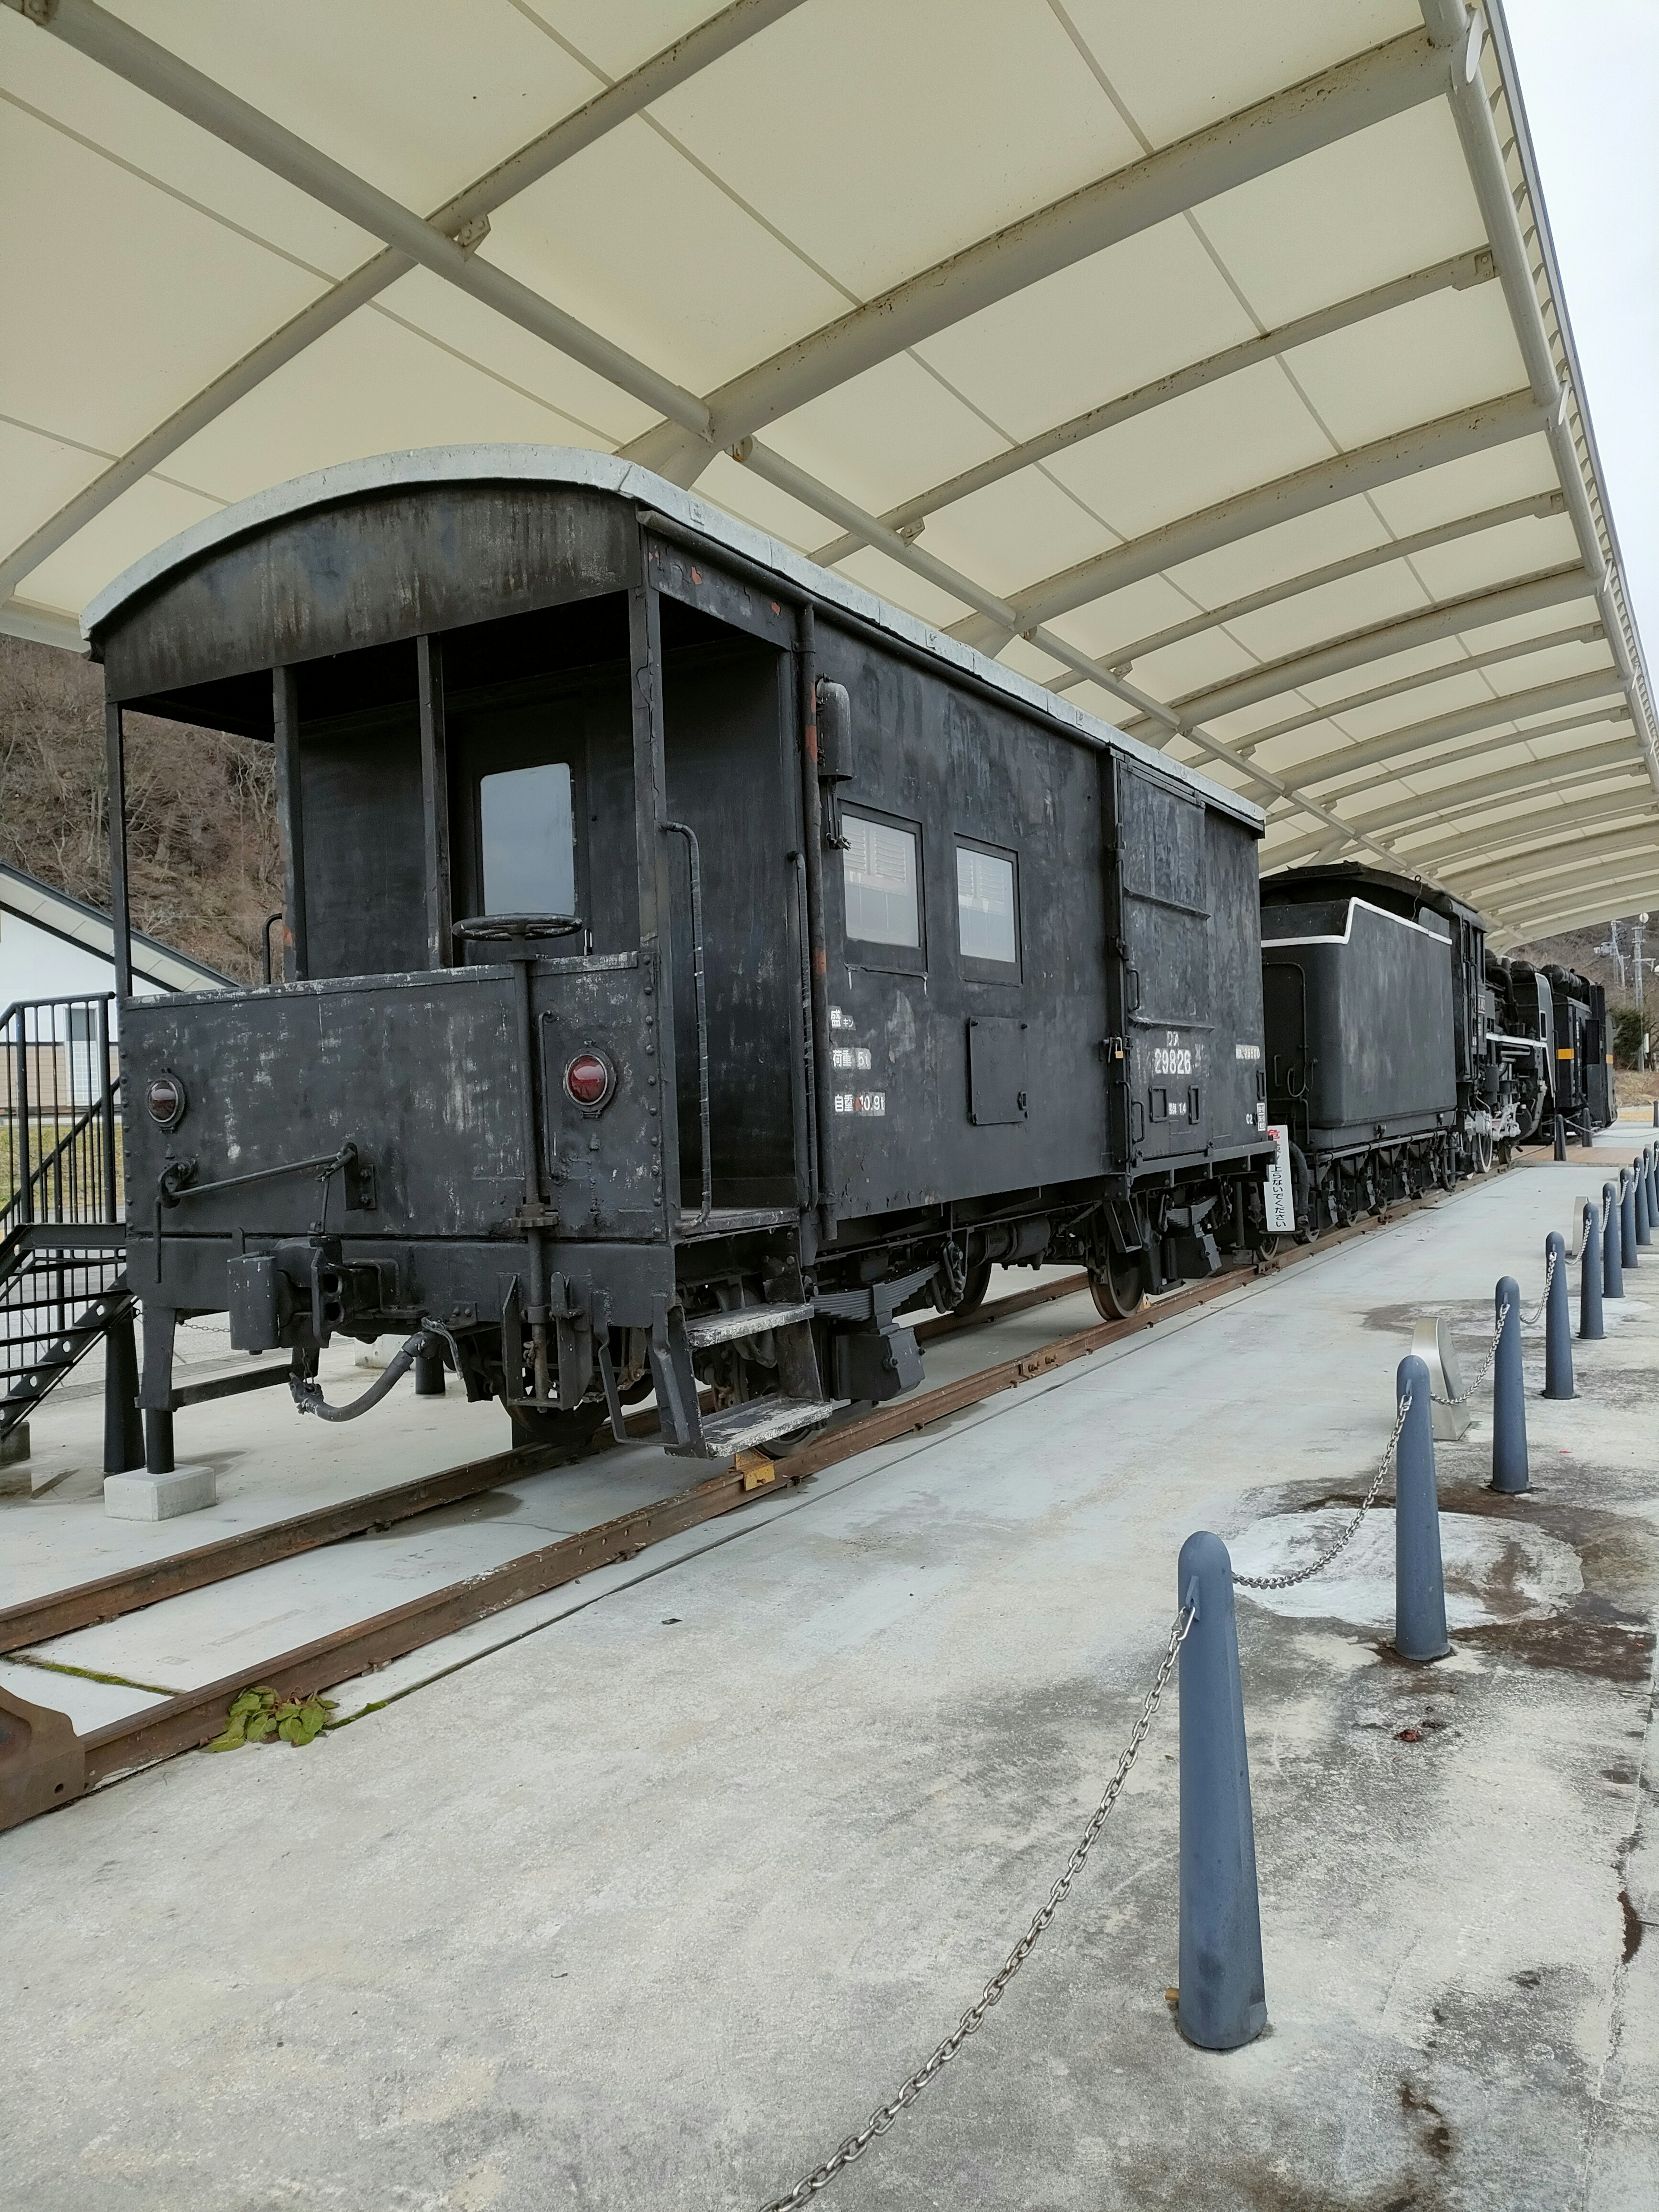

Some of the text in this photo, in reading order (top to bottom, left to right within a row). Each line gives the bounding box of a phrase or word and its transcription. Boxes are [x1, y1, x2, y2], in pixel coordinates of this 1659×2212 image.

[831, 1009, 853, 1028] 盛キン
[833, 1049, 852, 1067] 荷重
[1155, 1049, 1191, 1074] 29826
[835, 1094, 853, 1112] 自重
